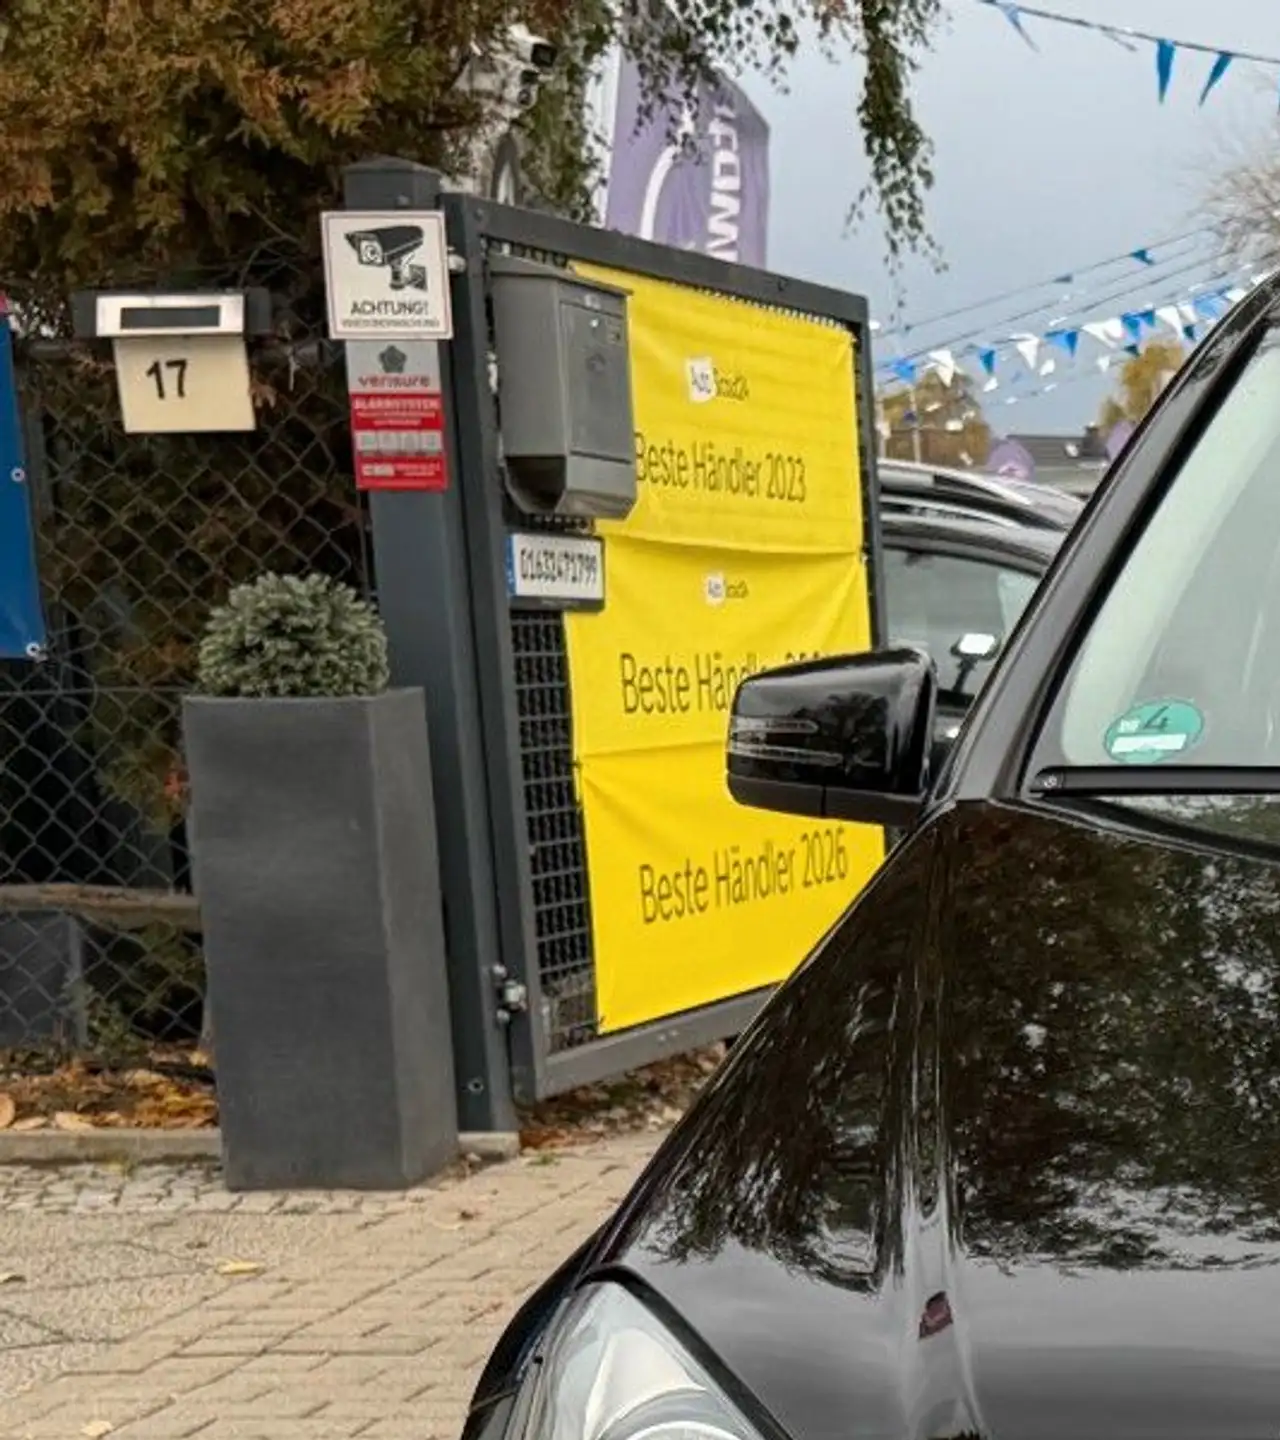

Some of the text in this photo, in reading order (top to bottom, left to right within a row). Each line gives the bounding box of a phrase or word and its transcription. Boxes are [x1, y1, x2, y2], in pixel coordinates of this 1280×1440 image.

[350, 300, 429, 316] ACHTUNG!
[146, 359, 187, 400] 17
[634, 432, 807, 503] Beste Händler 2023
[620, 652, 691, 714] Beste
[1143, 705, 1169, 733] 4
[639, 826, 849, 925] Beste Händler 2026
